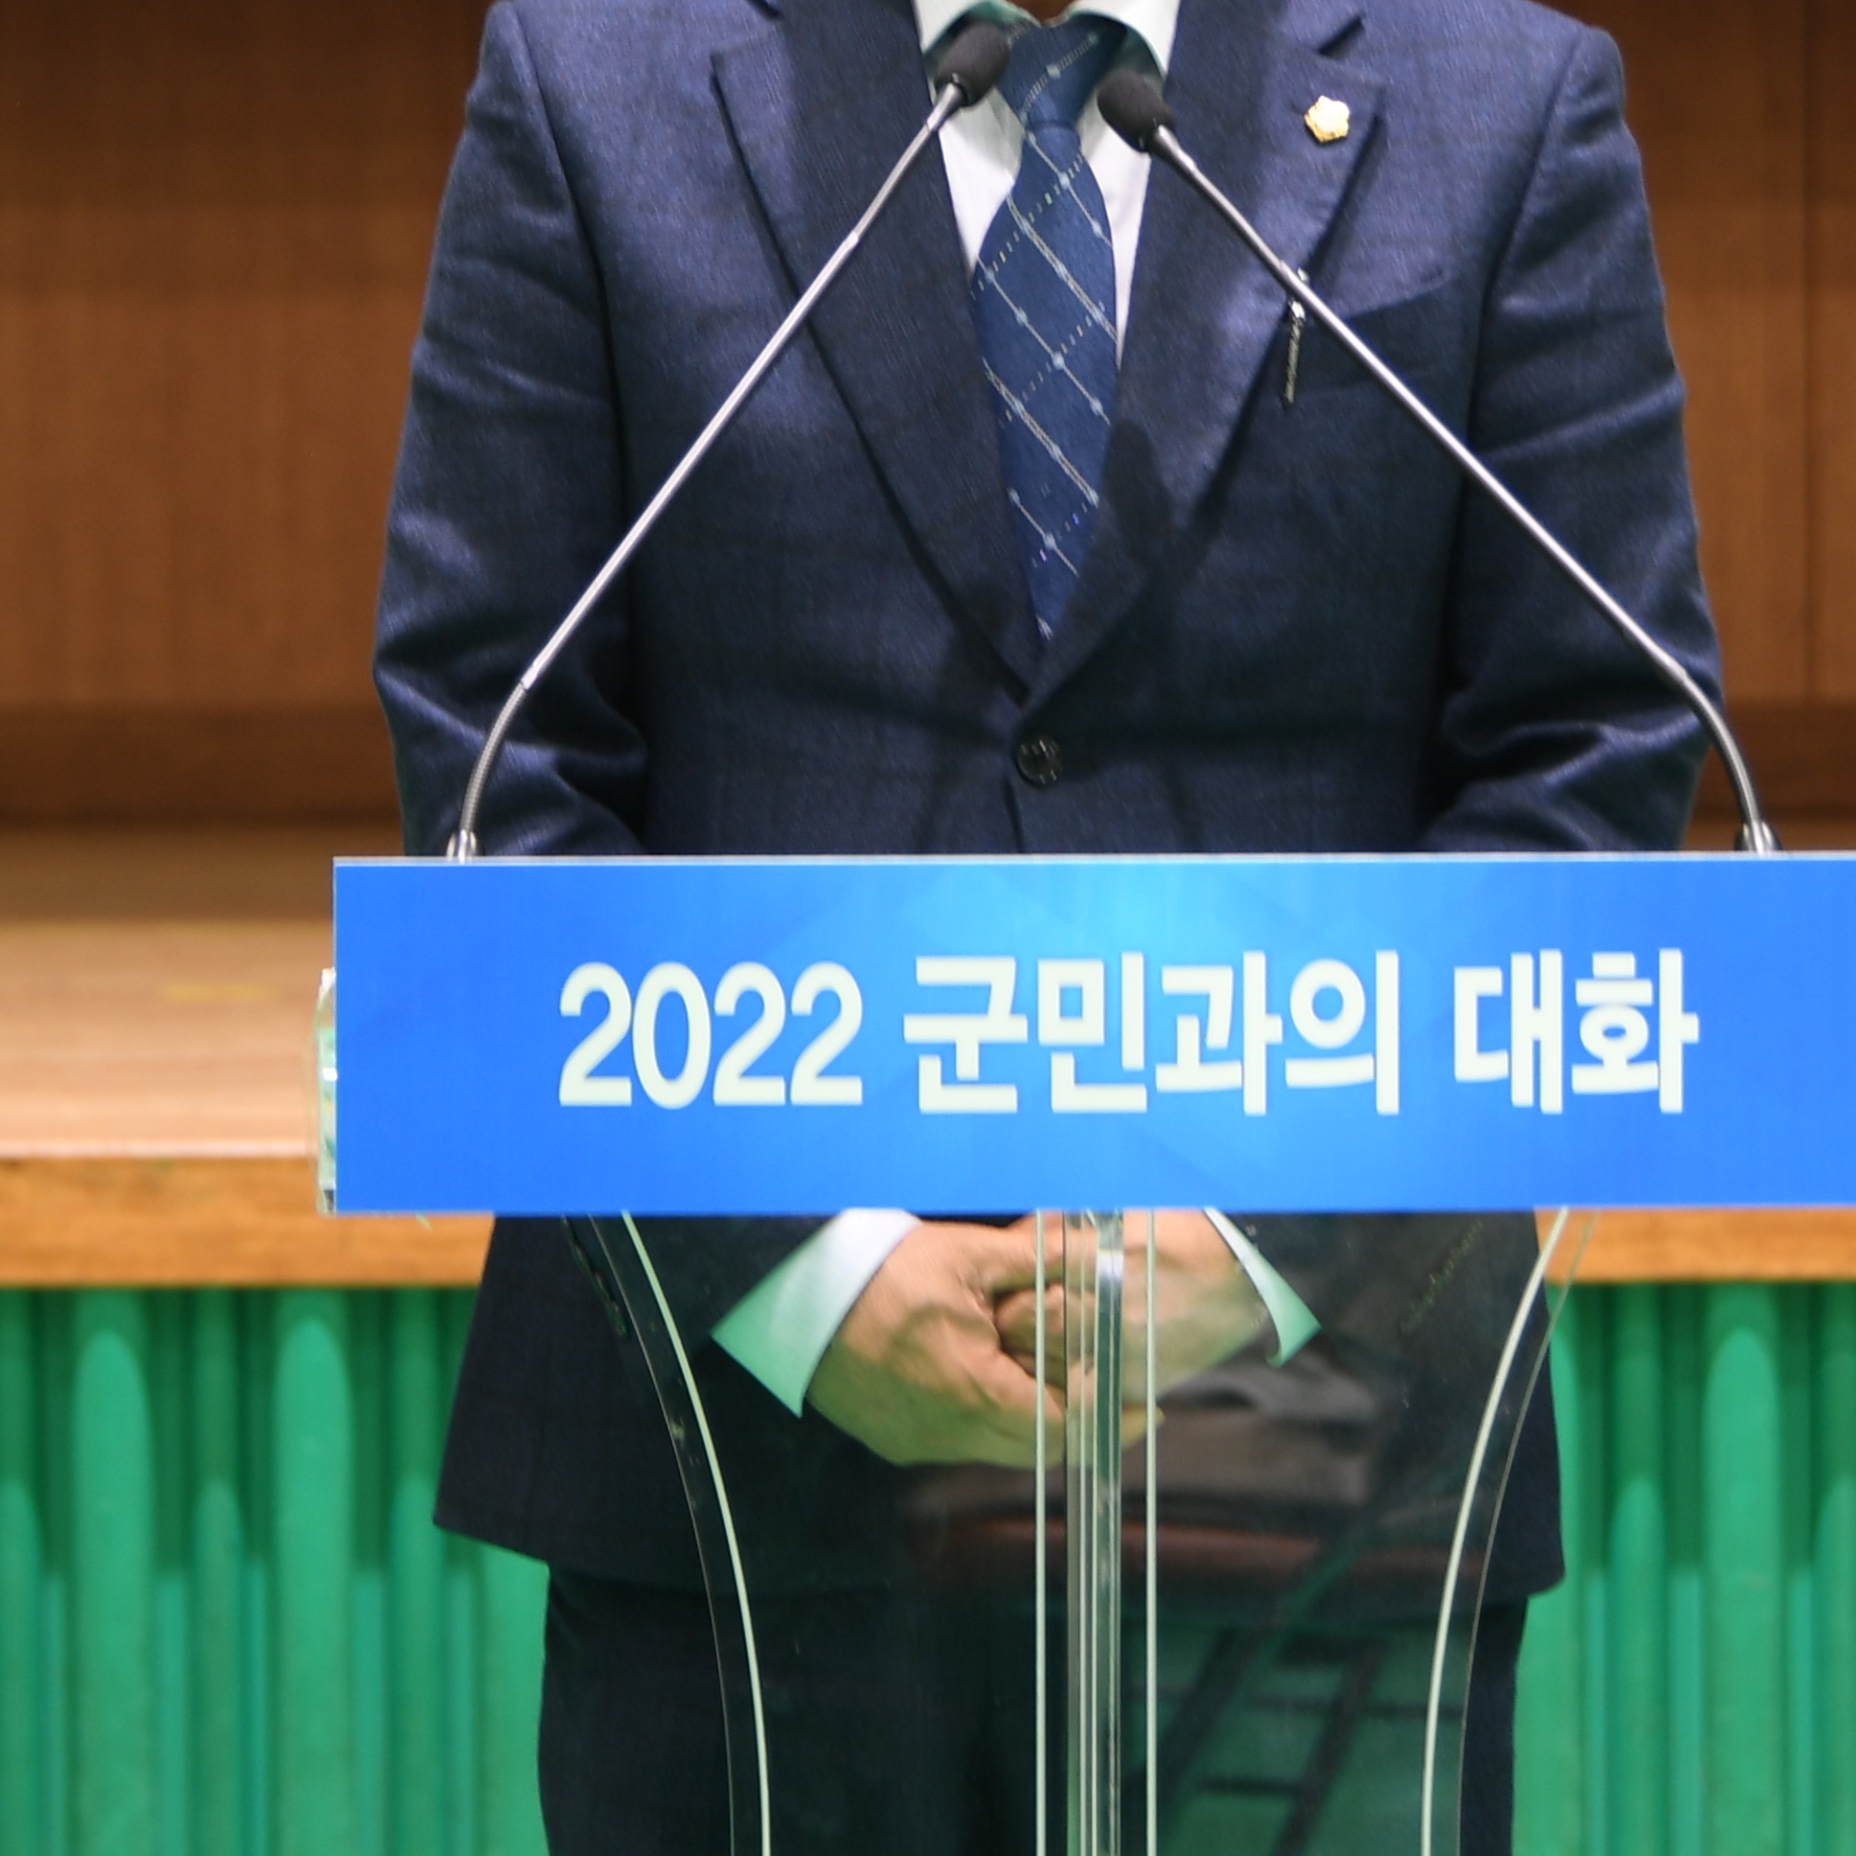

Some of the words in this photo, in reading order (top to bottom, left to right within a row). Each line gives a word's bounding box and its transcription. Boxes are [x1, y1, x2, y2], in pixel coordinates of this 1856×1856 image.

[558, 961, 863, 1109] 2022
[902, 948, 1400, 1116] 군민과의
[1453, 947, 1700, 1114] 대화
